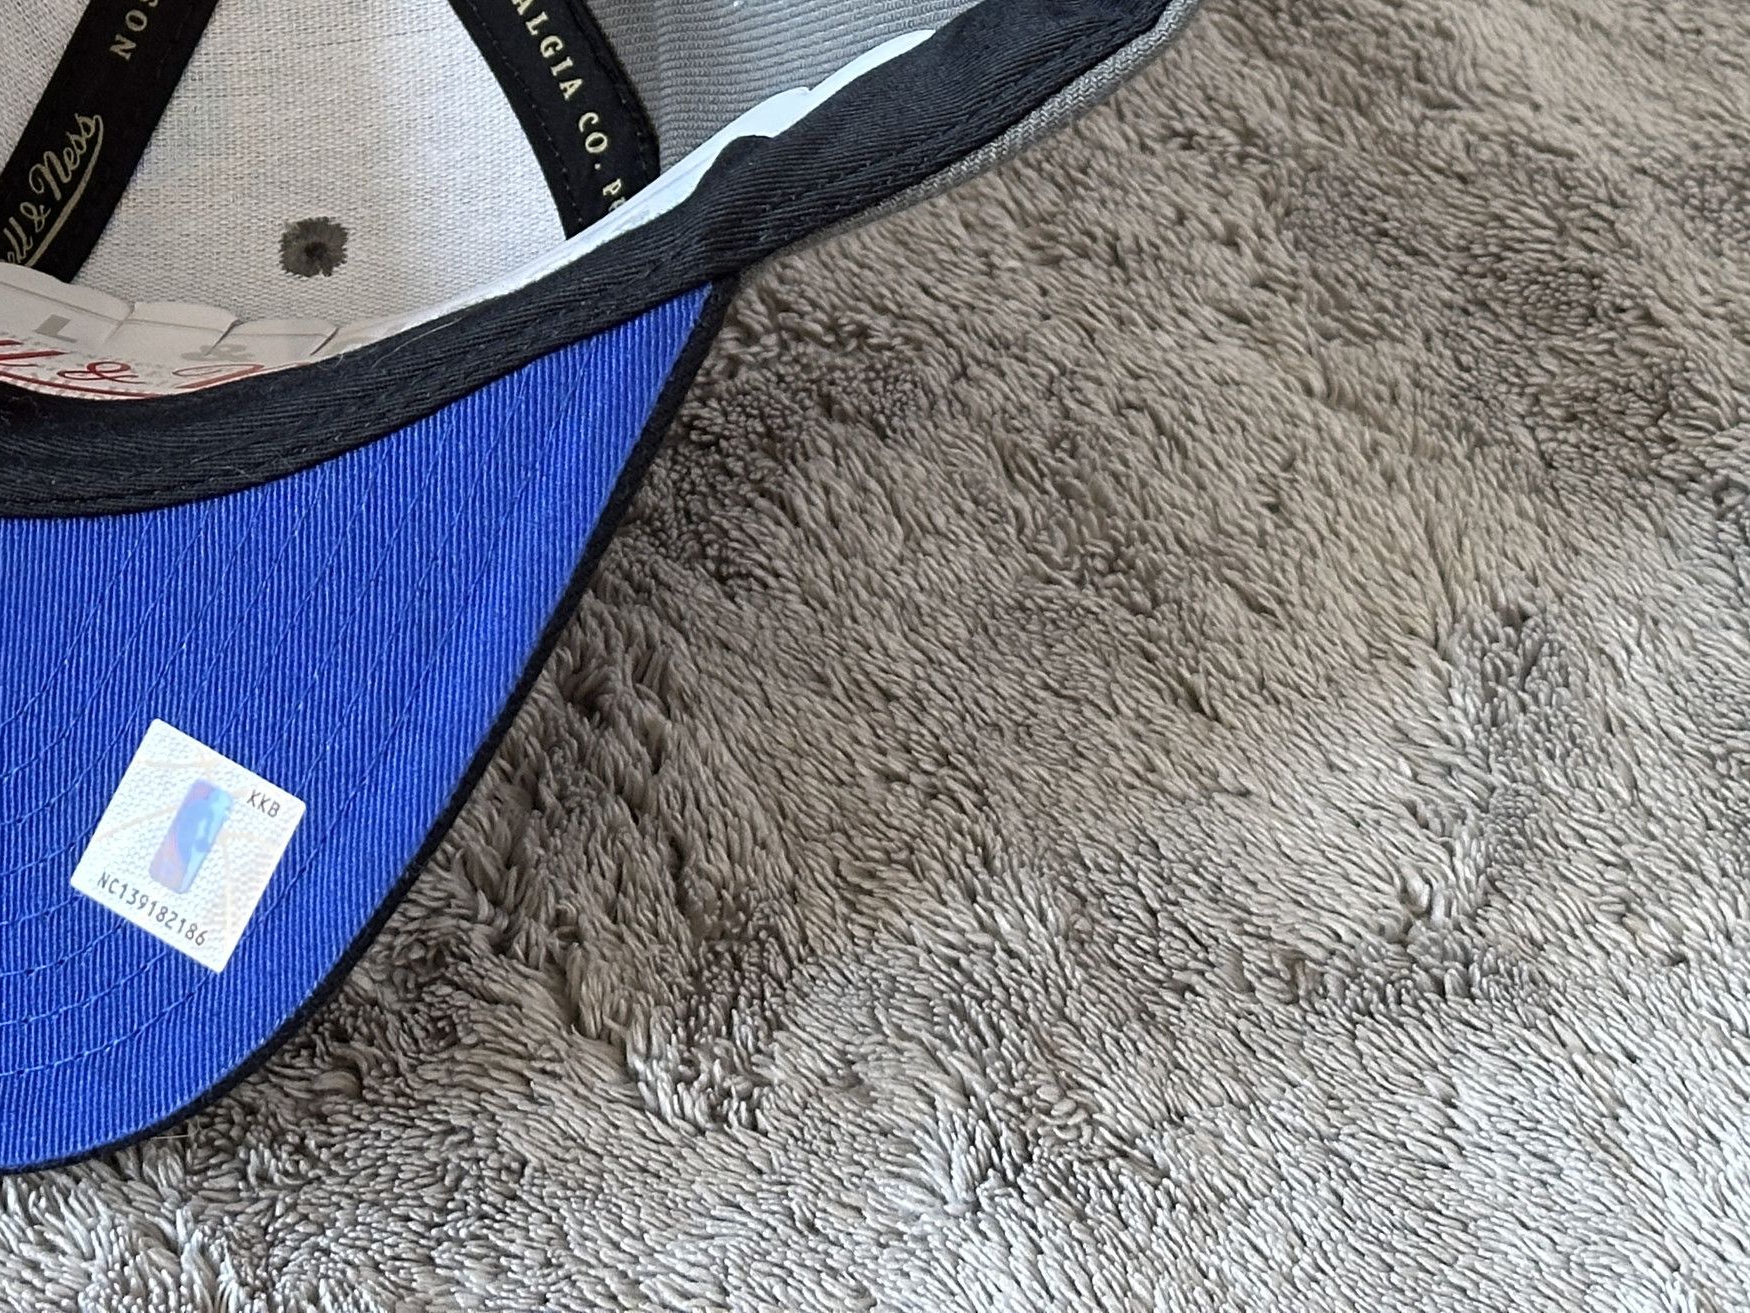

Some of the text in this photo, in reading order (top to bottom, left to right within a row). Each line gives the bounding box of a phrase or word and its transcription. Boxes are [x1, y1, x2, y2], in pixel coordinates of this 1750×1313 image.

[28, 112, 104, 201] Ness
[578, 111, 608, 170] CO.
[19, 201, 52, 233] &
[56, 360, 146, 385] &
[246, 789, 282, 819] KKB
[96, 871, 210, 948] NC139182186
